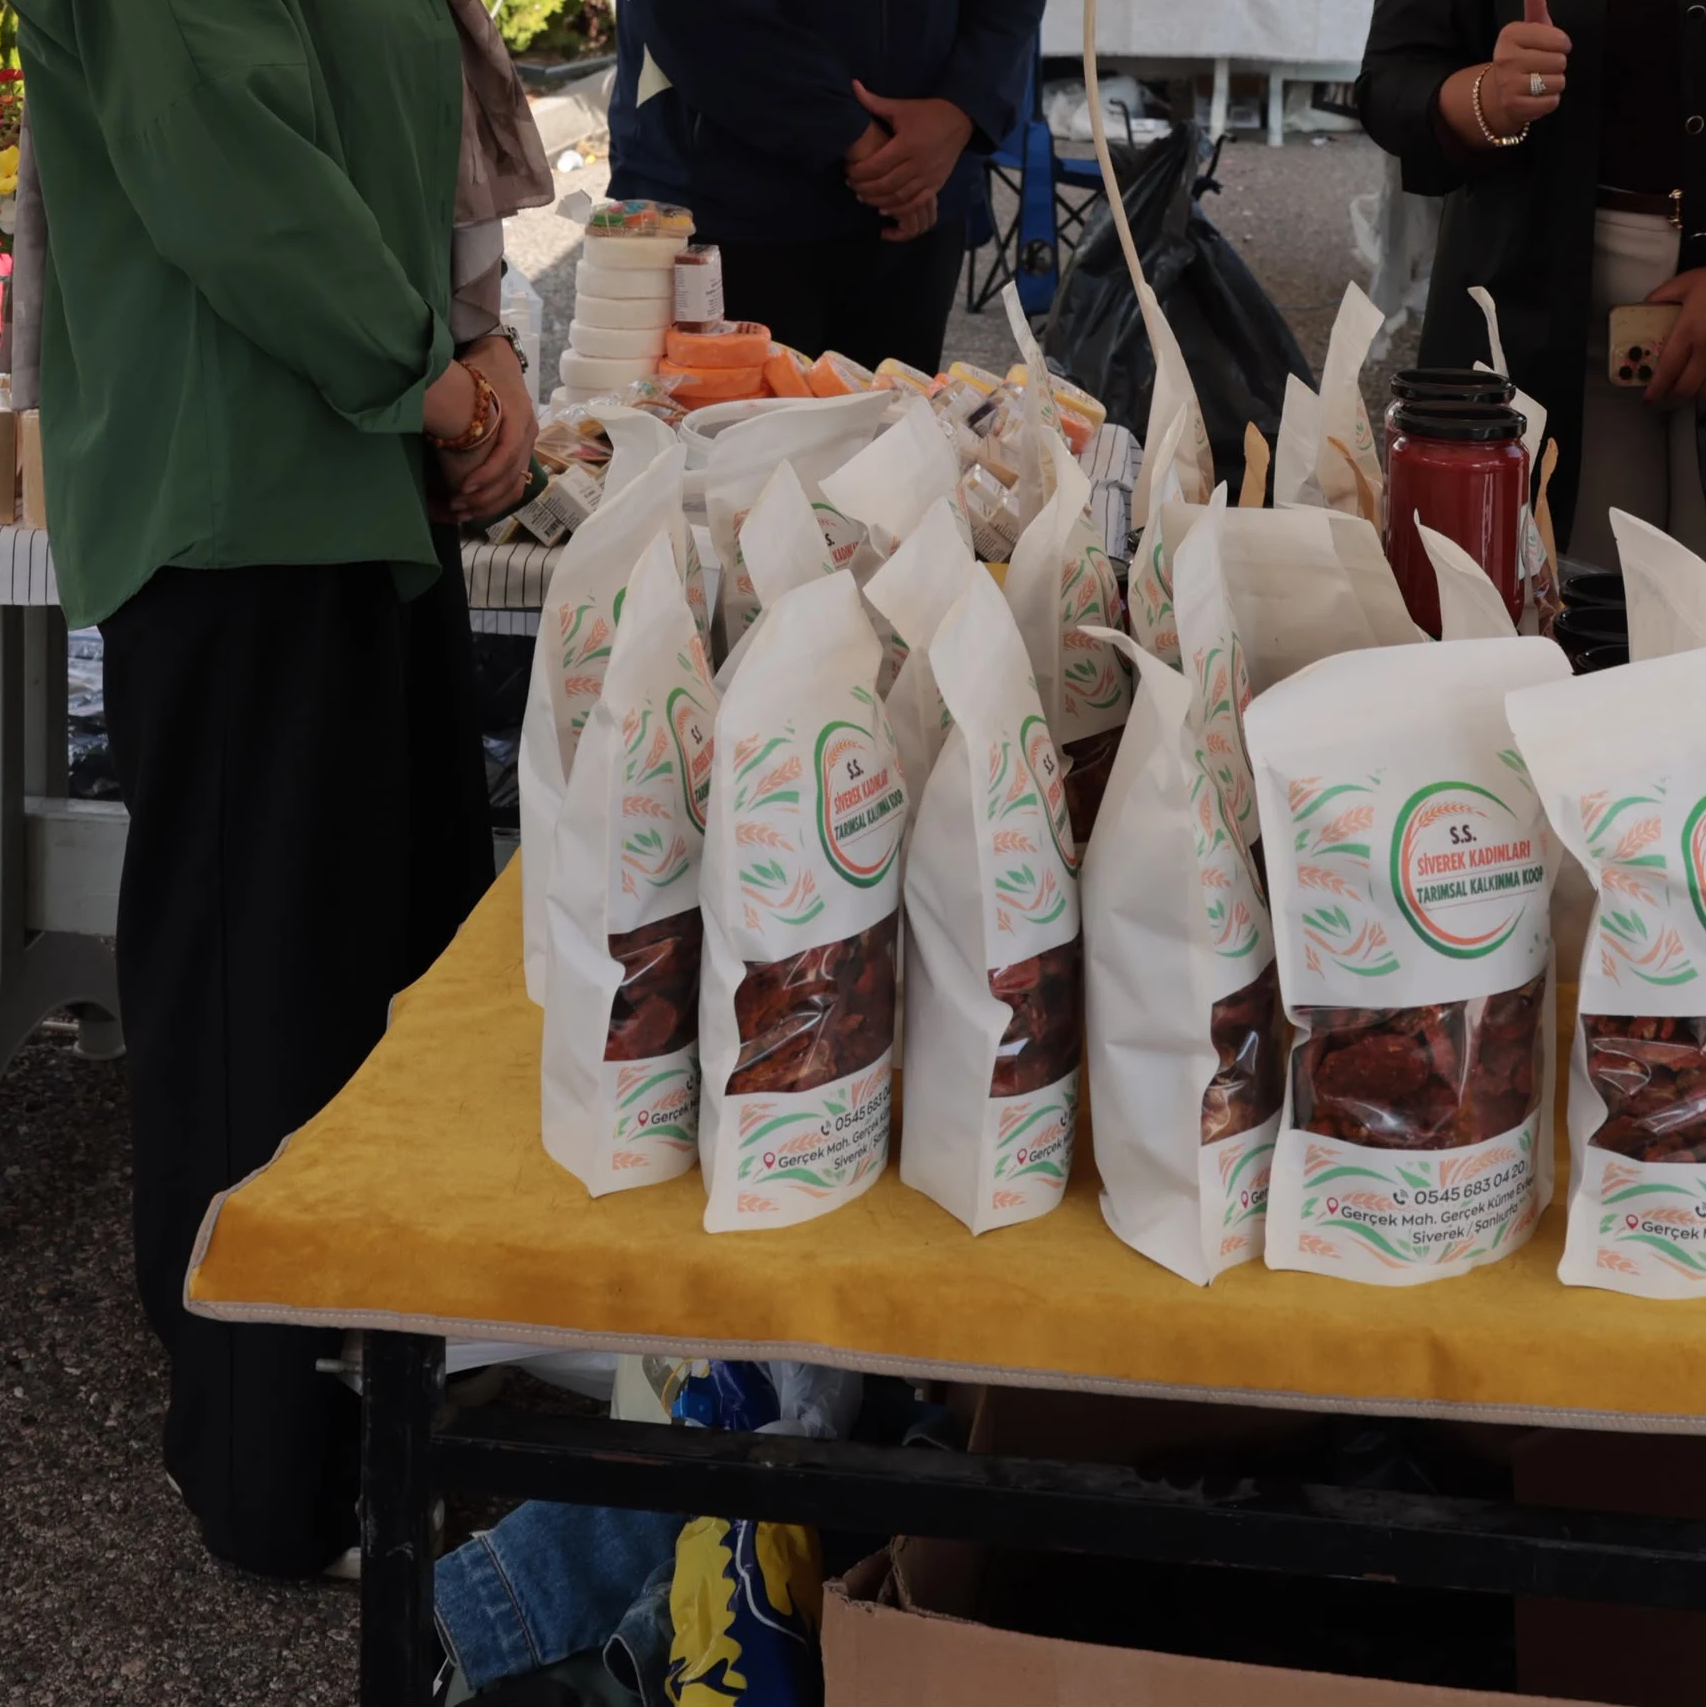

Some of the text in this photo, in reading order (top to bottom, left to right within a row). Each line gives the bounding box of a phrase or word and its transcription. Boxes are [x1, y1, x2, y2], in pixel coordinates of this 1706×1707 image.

[1449, 824, 1477, 845] S.S.
[1417, 840, 1531, 877] SİVEREK KADINLARI
[1416, 880, 1468, 905] TARIMSAL
[1469, 870, 1520, 895] KALKINMA
[651, 1102, 689, 1125] Gerçek
[835, 1104, 865, 1131] 0545
[778, 1147, 825, 1170] Gerçek
[827, 1137, 851, 1155] Mah.
[834, 1144, 868, 1170] Siverek
[1029, 1138, 1063, 1162] Gerçek
[1414, 1160, 1525, 1205] 0545 683 04 20
[1341, 1205, 1397, 1227] Gerçek
[1401, 1213, 1437, 1227] Mah.
[1440, 1201, 1485, 1224] Gerçek
[1487, 1189, 1515, 1210] Küme
[1412, 1228, 1464, 1245] Siverek
[1641, 1220, 1699, 1241] Gerçek
